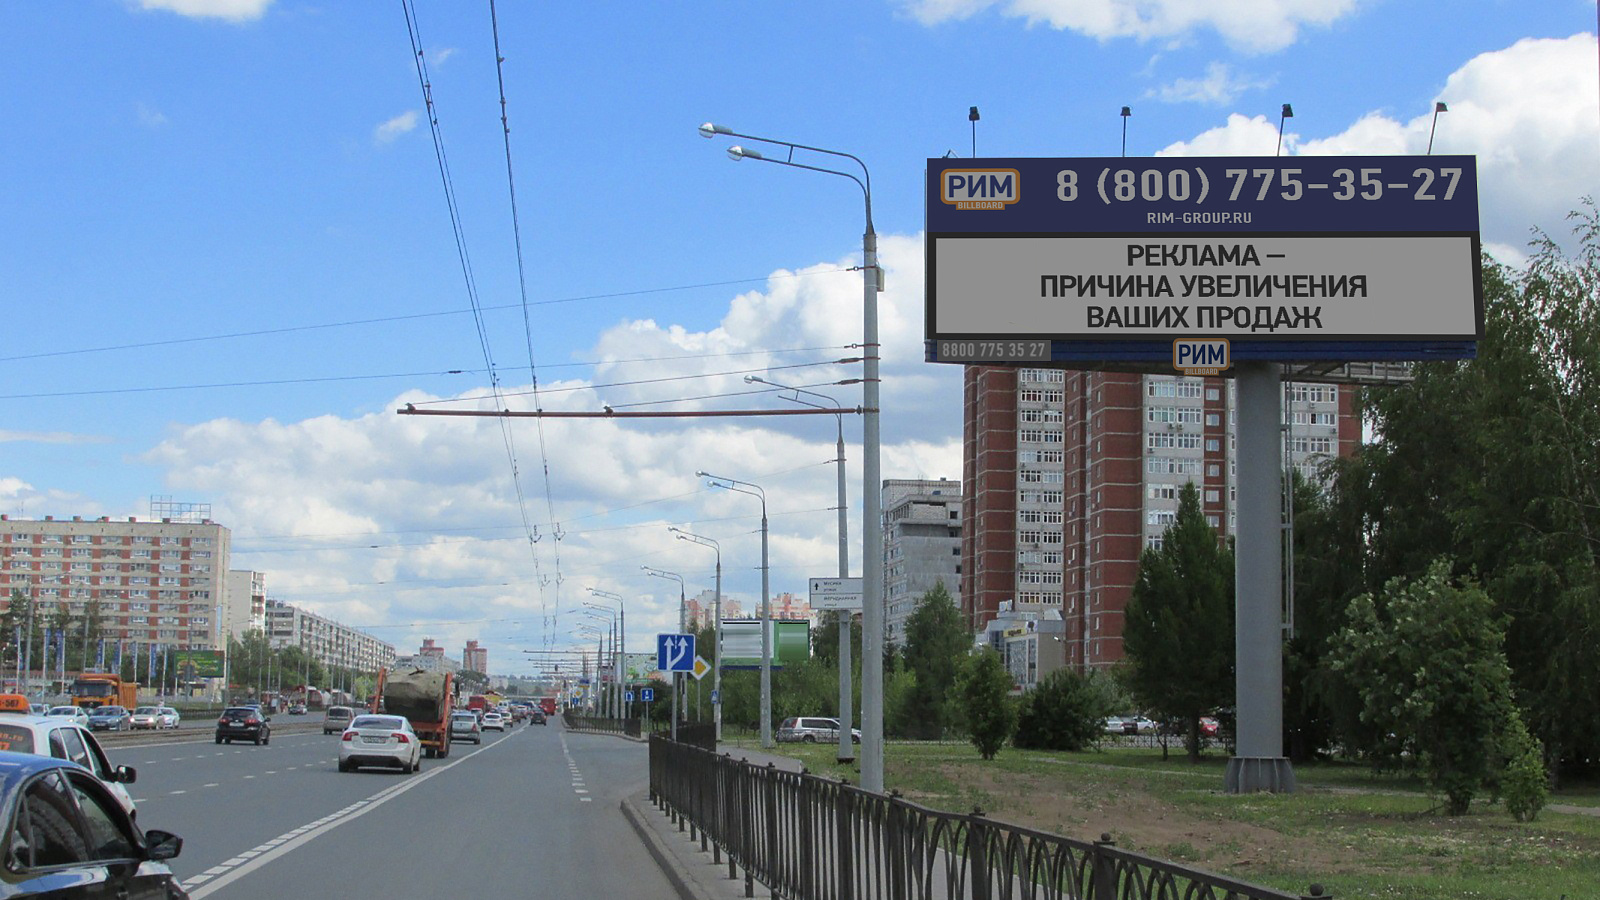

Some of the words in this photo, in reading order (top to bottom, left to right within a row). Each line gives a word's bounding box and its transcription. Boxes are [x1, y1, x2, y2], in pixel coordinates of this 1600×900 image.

[948, 174, 1013, 198] РИМ
[1056, 169, 1078, 202] 8
[1097, 167, 1210, 205] (800)
[1225, 167, 1463, 201] 775-35-27
[957, 201, 1004, 209] BILLBOARD
[1146, 212, 1252, 224] RIM-GROUP.RU
[1127, 244, 1261, 266] РЕКЛАМА
[1040, 275, 1175, 298] ПРИЧИНА
[1181, 274, 1368, 298] УВЕЛИЧЕНИЯ
[1086, 306, 1190, 328] ВАШИХ
[1196, 306, 1323, 333] ПРОДАЖ
[942, 342, 975, 357] 8800
[980, 342, 1004, 357] 775
[1008, 342, 1025, 357] 35
[1029, 342, 1046, 357] 27
[1178, 344, 1225, 365] РИМ
